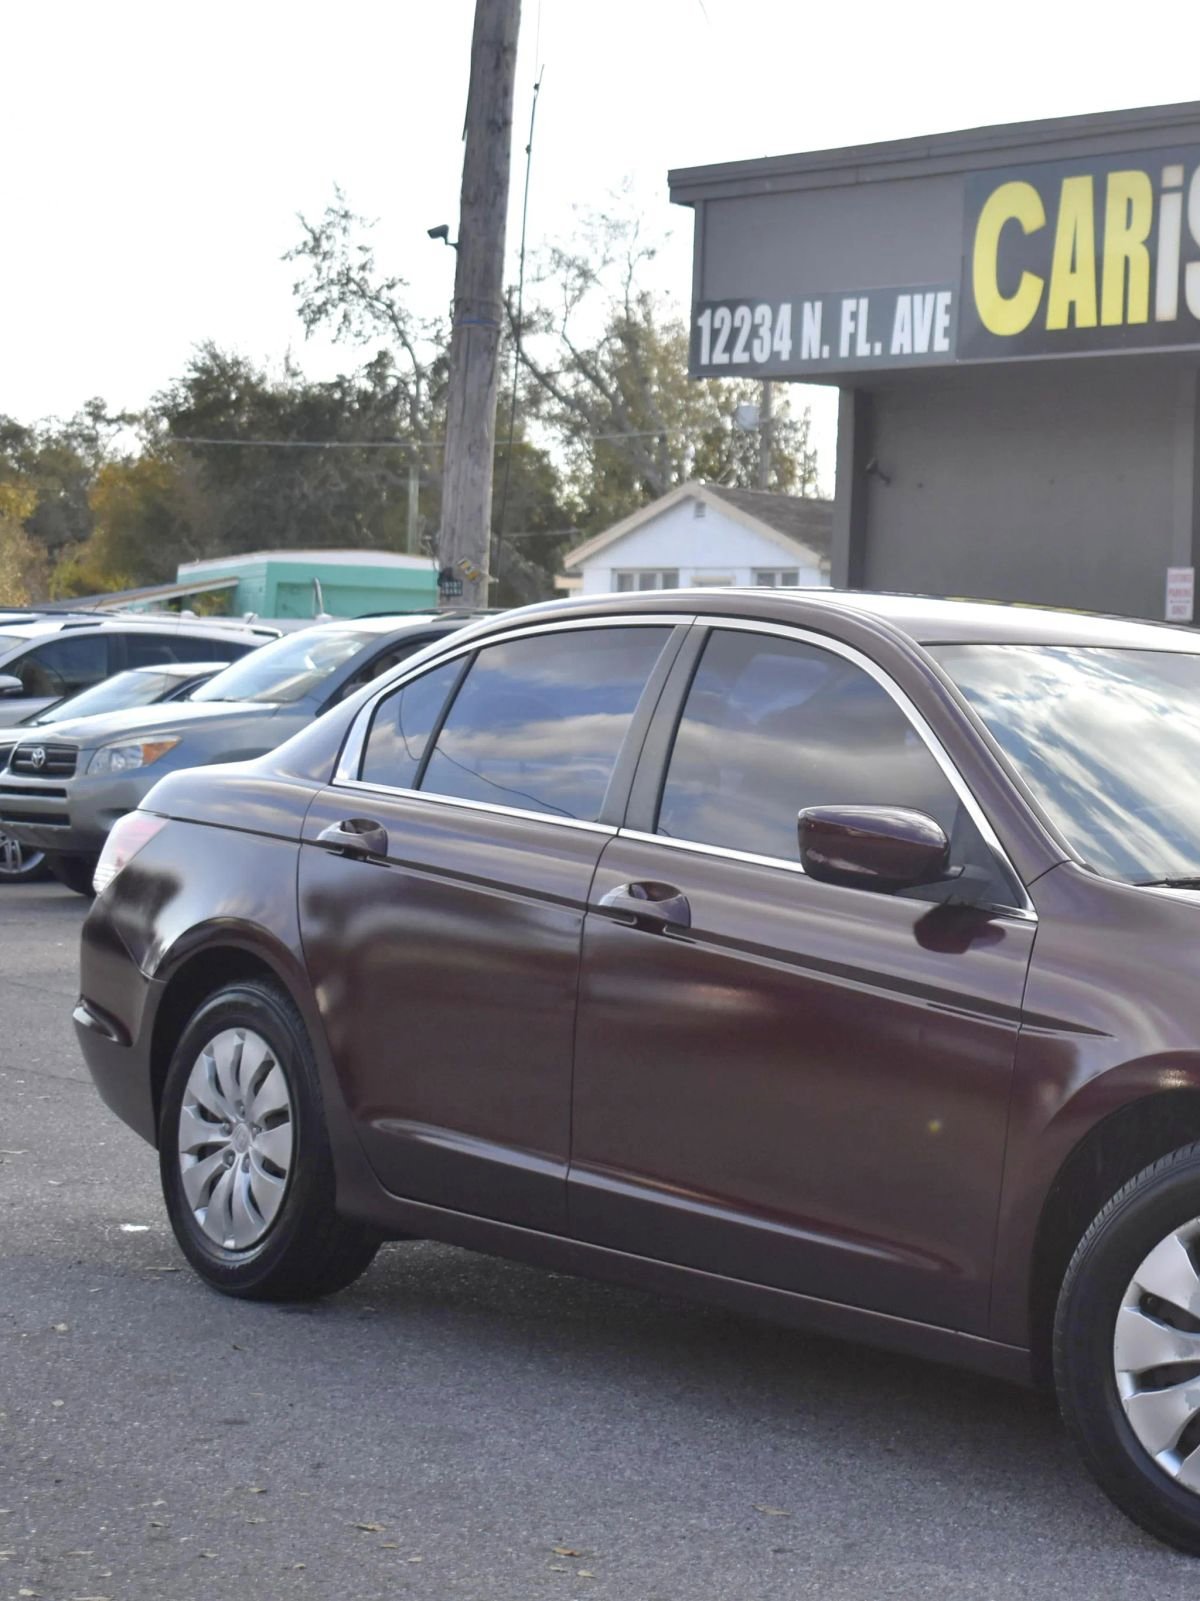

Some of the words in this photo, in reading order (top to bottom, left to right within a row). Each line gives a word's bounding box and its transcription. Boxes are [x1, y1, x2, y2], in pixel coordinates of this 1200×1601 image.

[697, 303, 792, 365] 12234
[801, 301, 830, 360] N.
[839, 298, 882, 358] FL.
[890, 291, 952, 355] AVE
